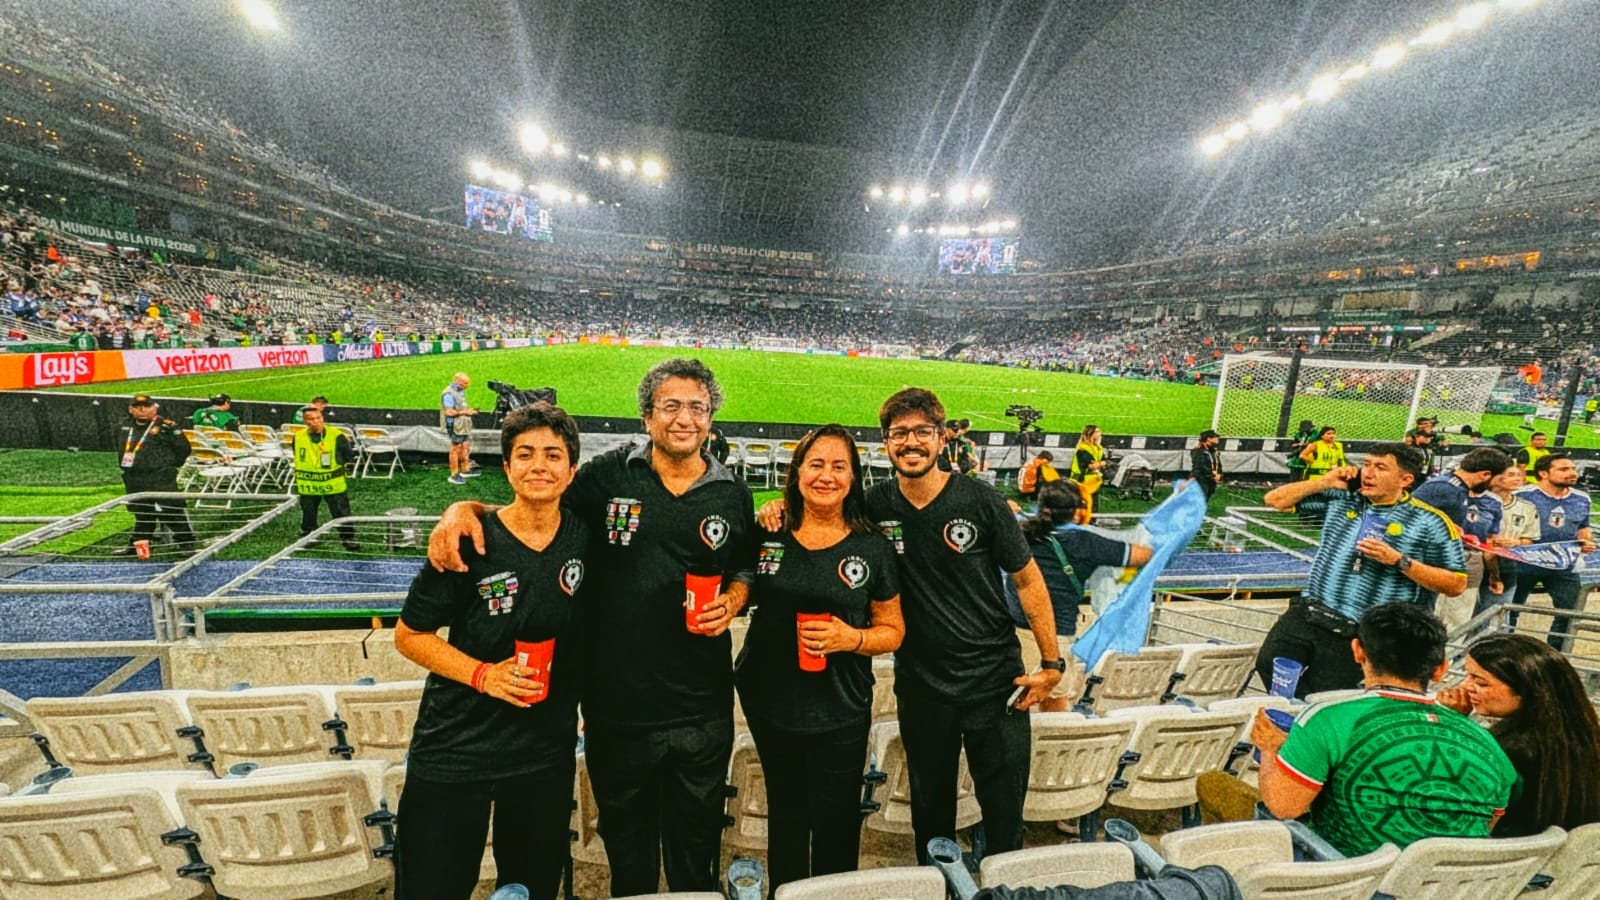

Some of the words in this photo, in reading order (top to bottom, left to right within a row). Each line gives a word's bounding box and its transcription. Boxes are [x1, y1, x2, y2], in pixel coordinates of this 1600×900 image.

[60, 220, 114, 240] MUNDIAL
[115, 230, 129, 242] DE
[130, 232, 144, 245] LA
[144, 235, 166, 248] FIFA
[167, 239, 197, 253] 2026
[697, 243, 717, 253] FIFA
[720, 245, 757, 257] WORLD
[758, 249, 778, 259] CUP
[258, 347, 310, 367] verizon
[381, 342, 410, 357] ULTRA
[34, 351, 89, 386] Lay's
[156, 349, 233, 376] verizon
[949, 518, 972, 526] INDIA
